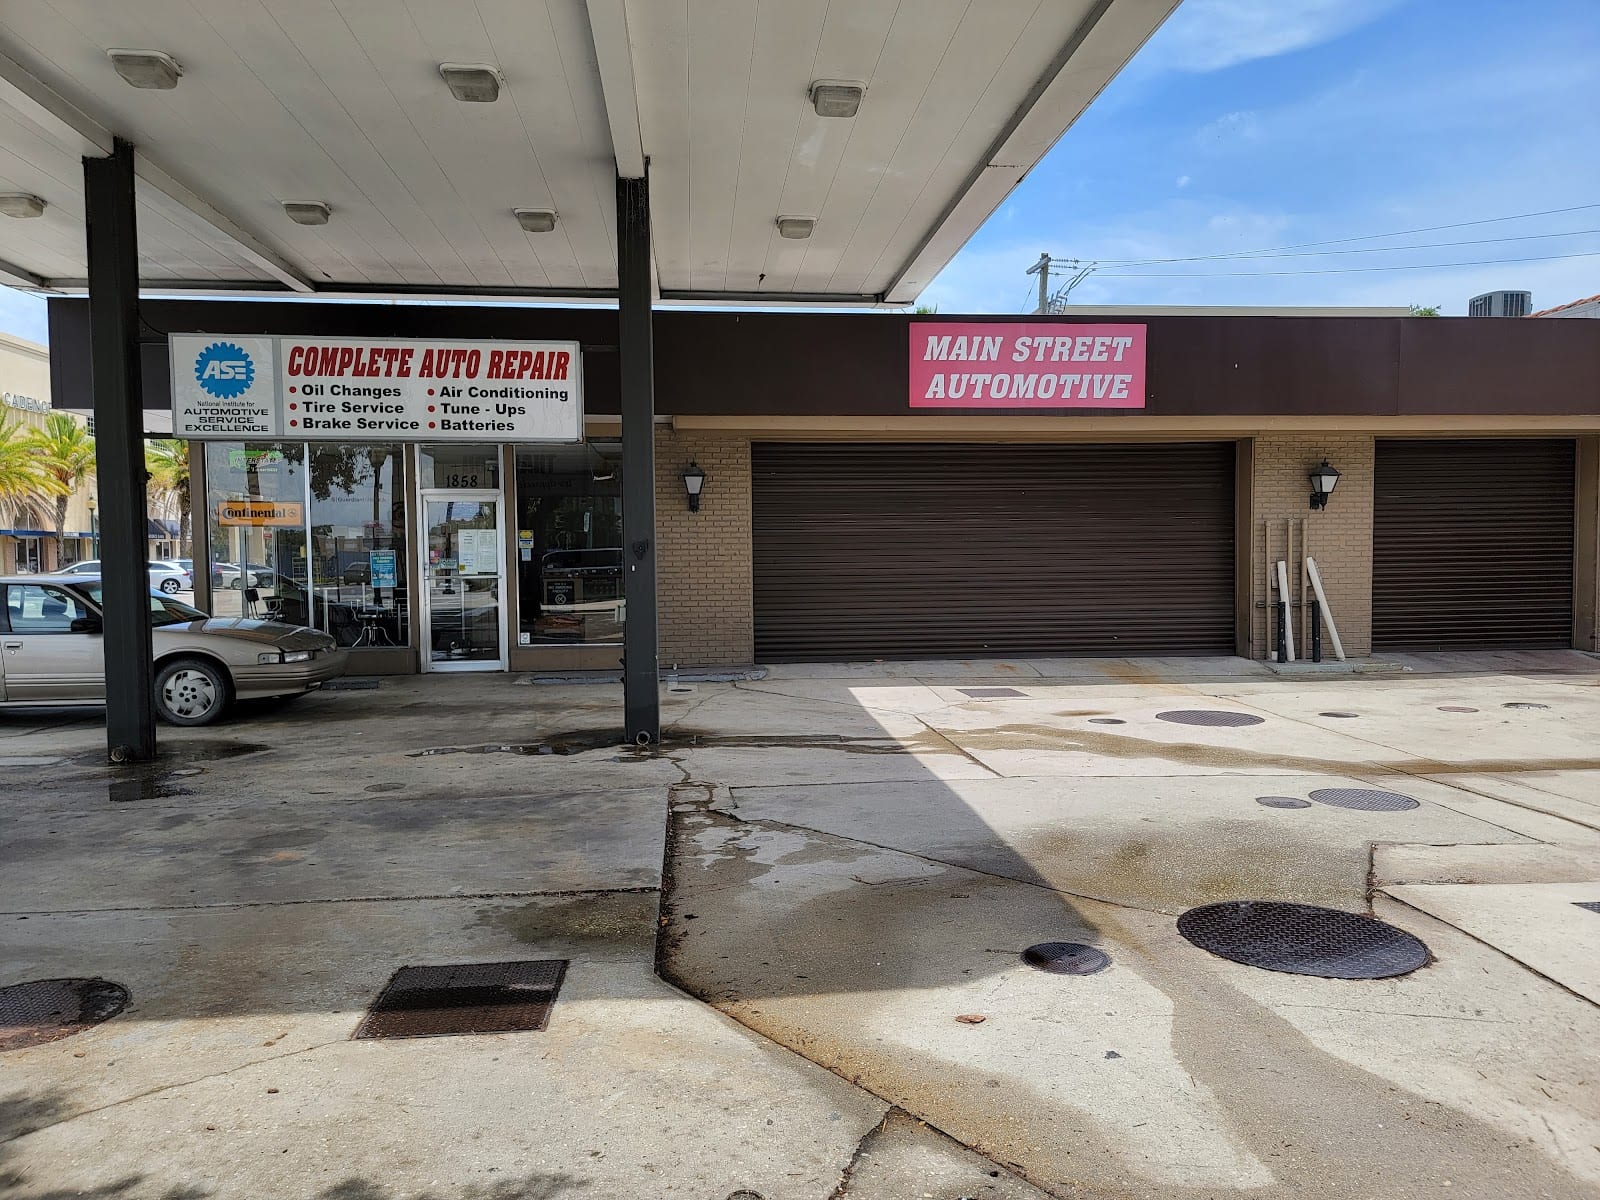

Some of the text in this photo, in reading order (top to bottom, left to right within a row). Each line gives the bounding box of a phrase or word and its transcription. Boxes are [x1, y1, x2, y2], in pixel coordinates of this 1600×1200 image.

[923, 336, 1133, 362] MAIN STREET
[202, 360, 246, 380] ASE
[288, 346, 570, 380] COMPLETE AUTO REPAIR
[301, 384, 402, 399] Oil Changes
[924, 373, 1133, 399] AUTOMOTIVE
[440, 386, 568, 402] Air Conditioning
[184, 408, 269, 416] AUTOMOTIVE
[302, 401, 404, 413] Tire Service
[440, 403, 481, 414] Tune
[495, 403, 526, 417] Ups
[199, 416, 254, 424] SERVICE
[303, 418, 420, 430] Brake Service
[441, 419, 515, 431] Batteries
[185, 424, 269, 432] EXCELLENCE
[447, 474, 478, 488] 1858
[222, 507, 286, 519] Continental
